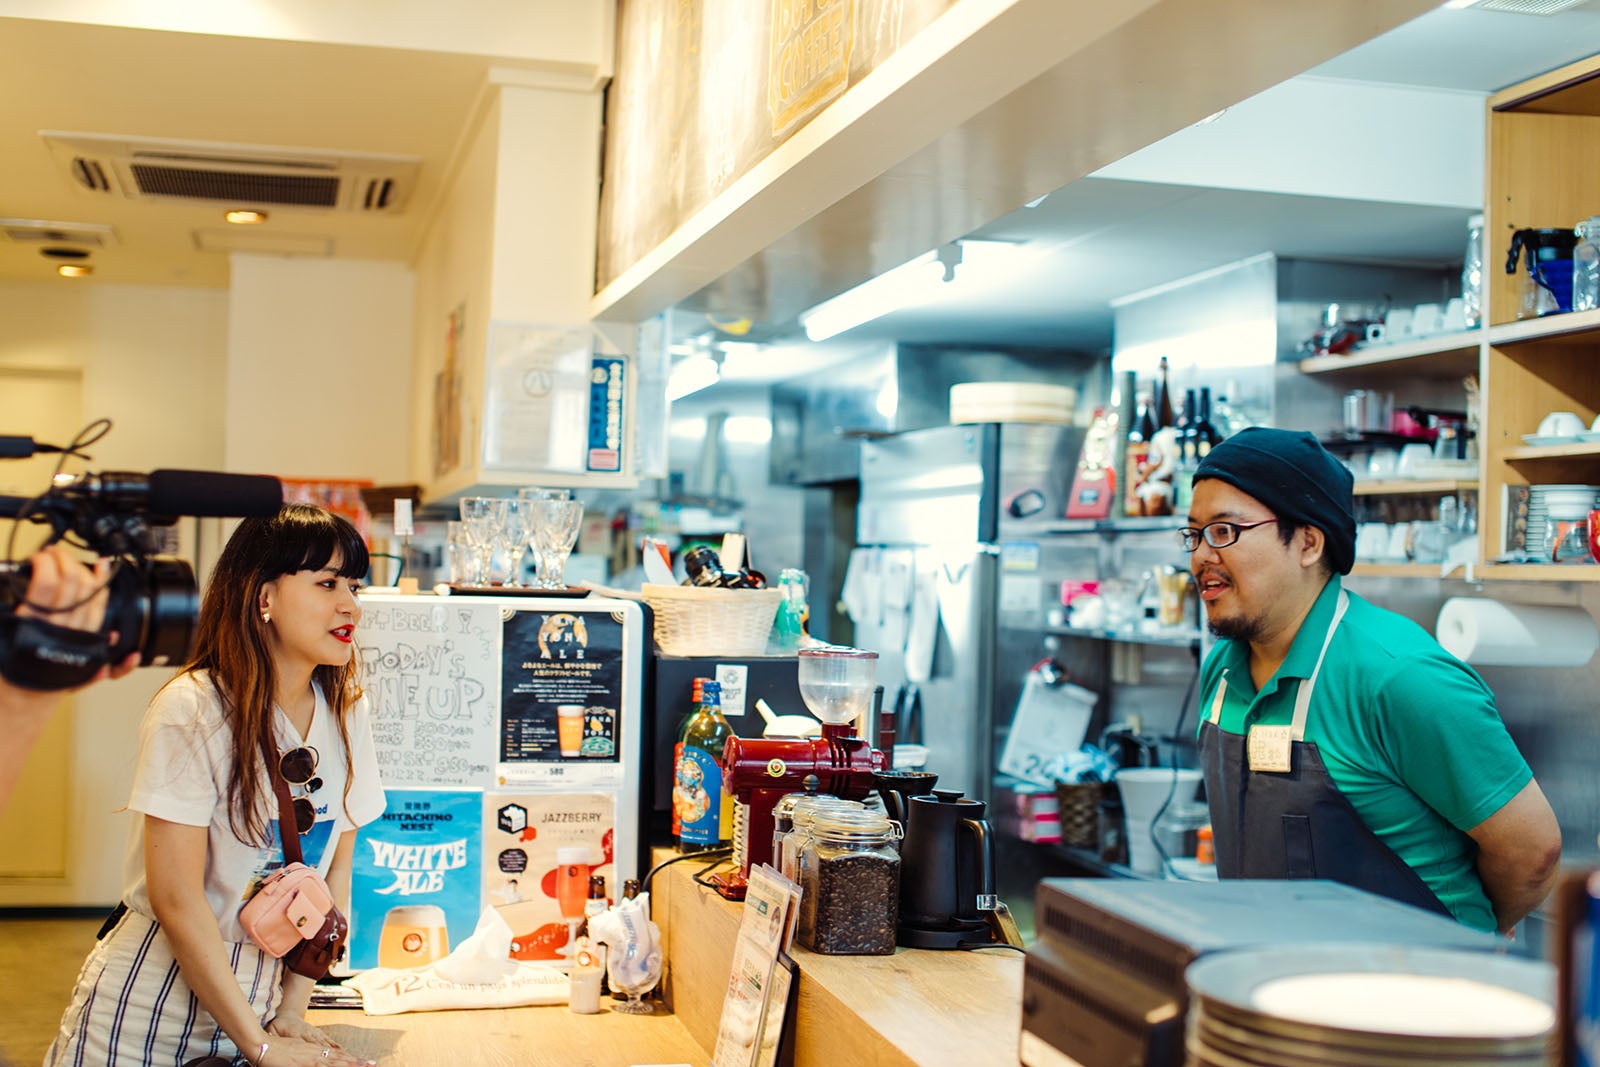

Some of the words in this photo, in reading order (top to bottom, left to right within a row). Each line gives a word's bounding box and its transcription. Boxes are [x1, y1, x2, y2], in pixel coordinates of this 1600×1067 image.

[361, 640, 466, 679] TODAY'S
[540, 649, 585, 660] ALE
[426, 677, 485, 721] UP
[381, 813, 453, 822] HITACHINO
[400, 822, 435, 832] NEST
[541, 812, 602, 824] JAZZBERRY
[366, 838, 467, 871] WHITE
[373, 869, 445, 896] ALE
